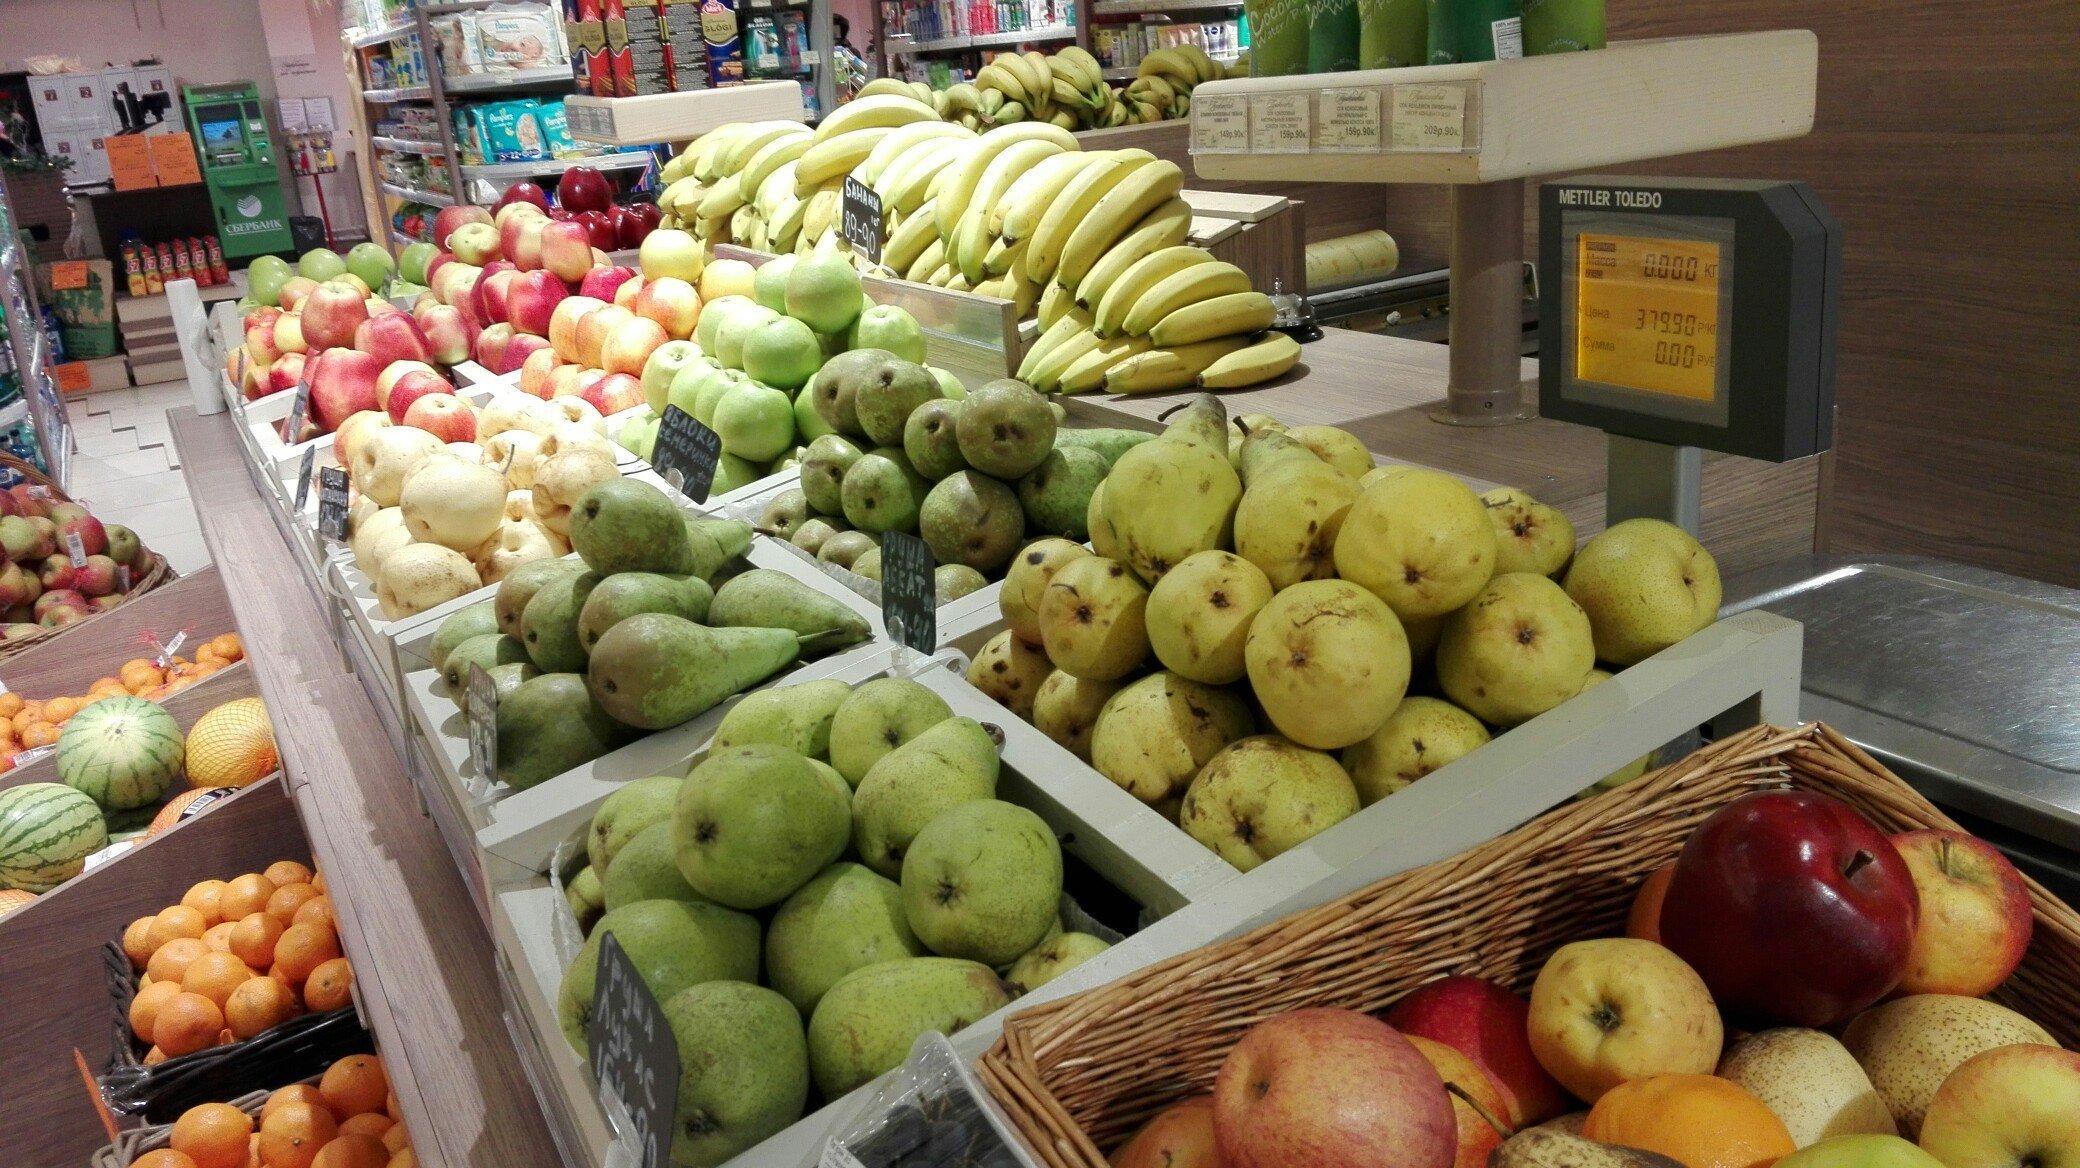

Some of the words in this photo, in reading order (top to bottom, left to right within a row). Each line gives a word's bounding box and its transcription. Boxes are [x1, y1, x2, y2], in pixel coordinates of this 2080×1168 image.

[1559, 189, 1610, 206] METTLER
[1614, 190, 1662, 209] TOLEDO
[225, 219, 283, 234] СБЕРБАНК
[1586, 253, 1616, 268] Масса
[1644, 253, 1698, 282] 0.000
[1584, 306, 1610, 321] Цена
[1583, 335, 1615, 352] Сумма
[1655, 340, 1695, 369] 0.00
